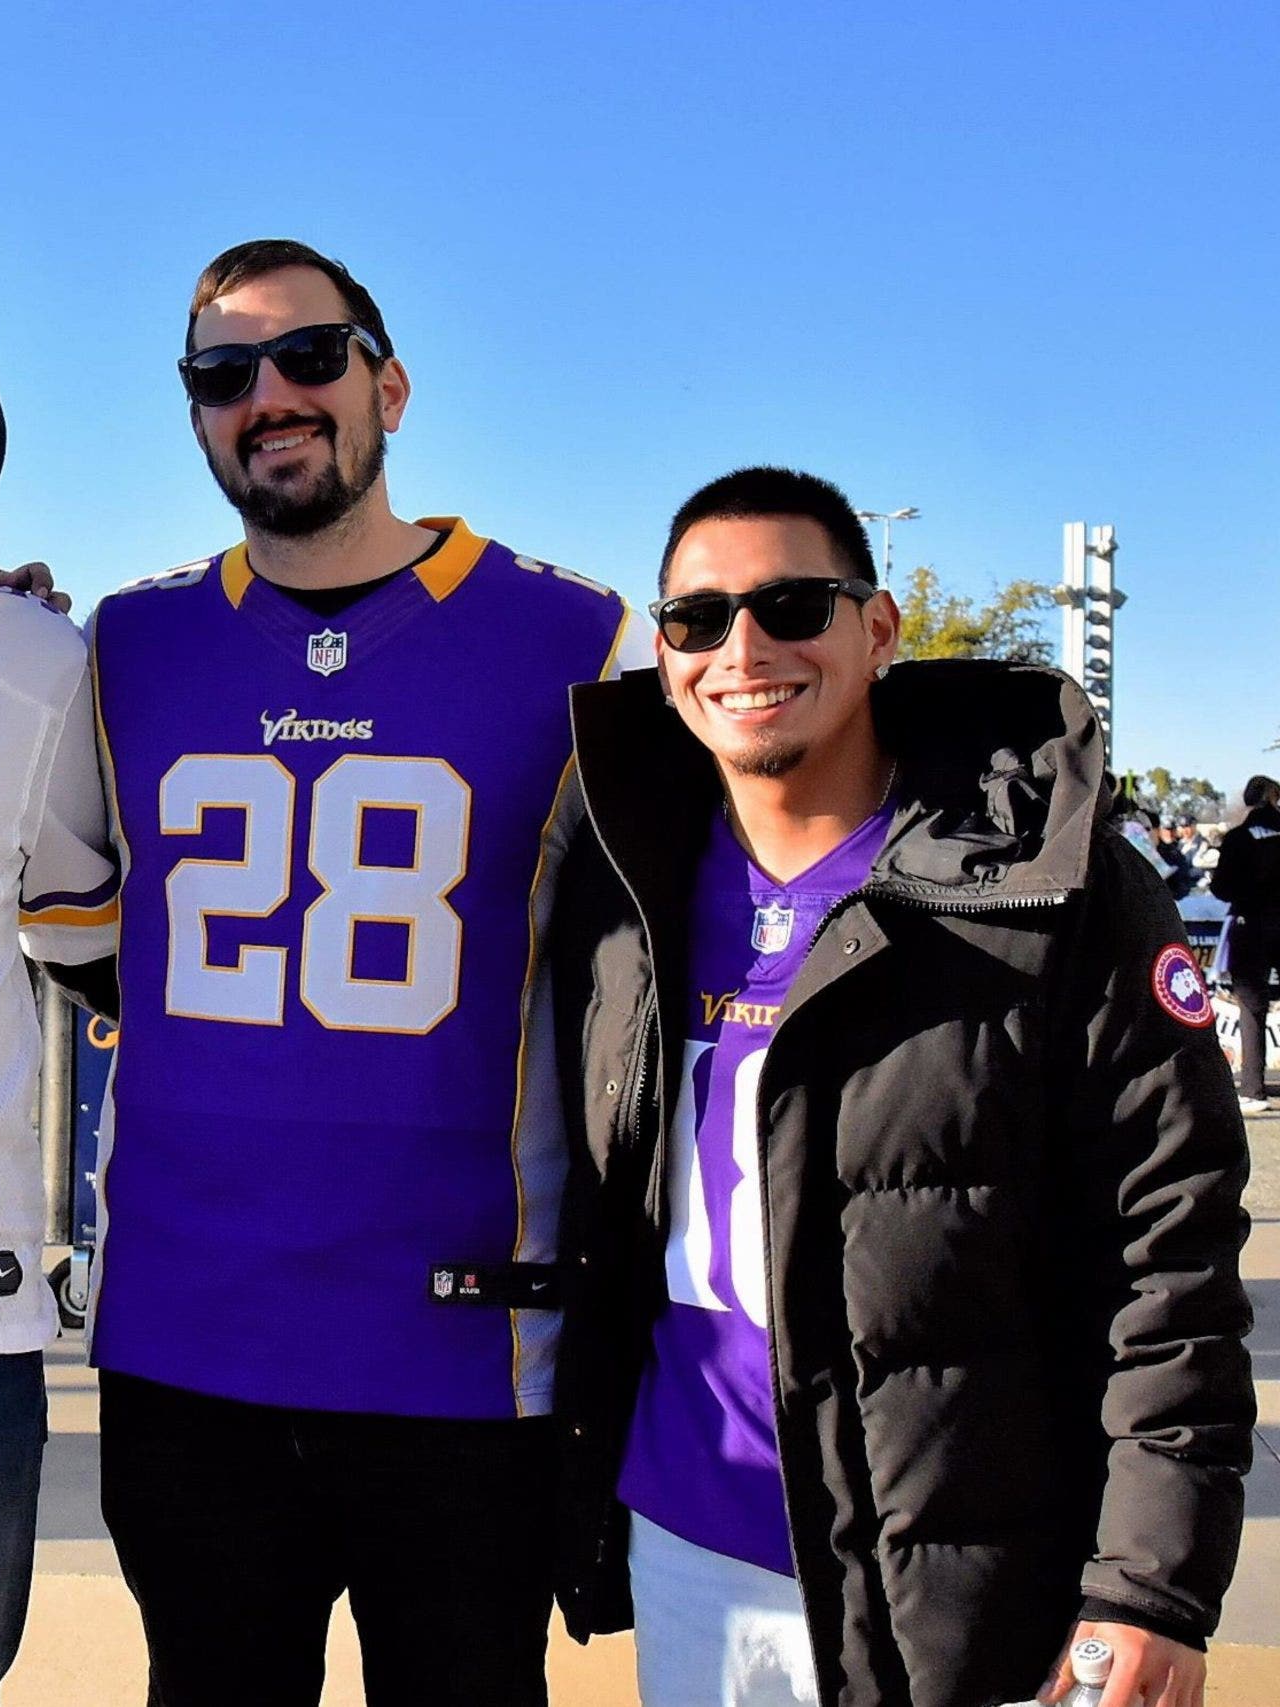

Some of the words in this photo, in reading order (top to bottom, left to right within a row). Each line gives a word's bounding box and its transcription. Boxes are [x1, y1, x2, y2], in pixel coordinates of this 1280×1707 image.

[313, 648, 342, 667] NFL
[260, 708, 374, 746] VIKINGS
[158, 753, 473, 1036] 28
[700, 988, 783, 1029] VIKIN
